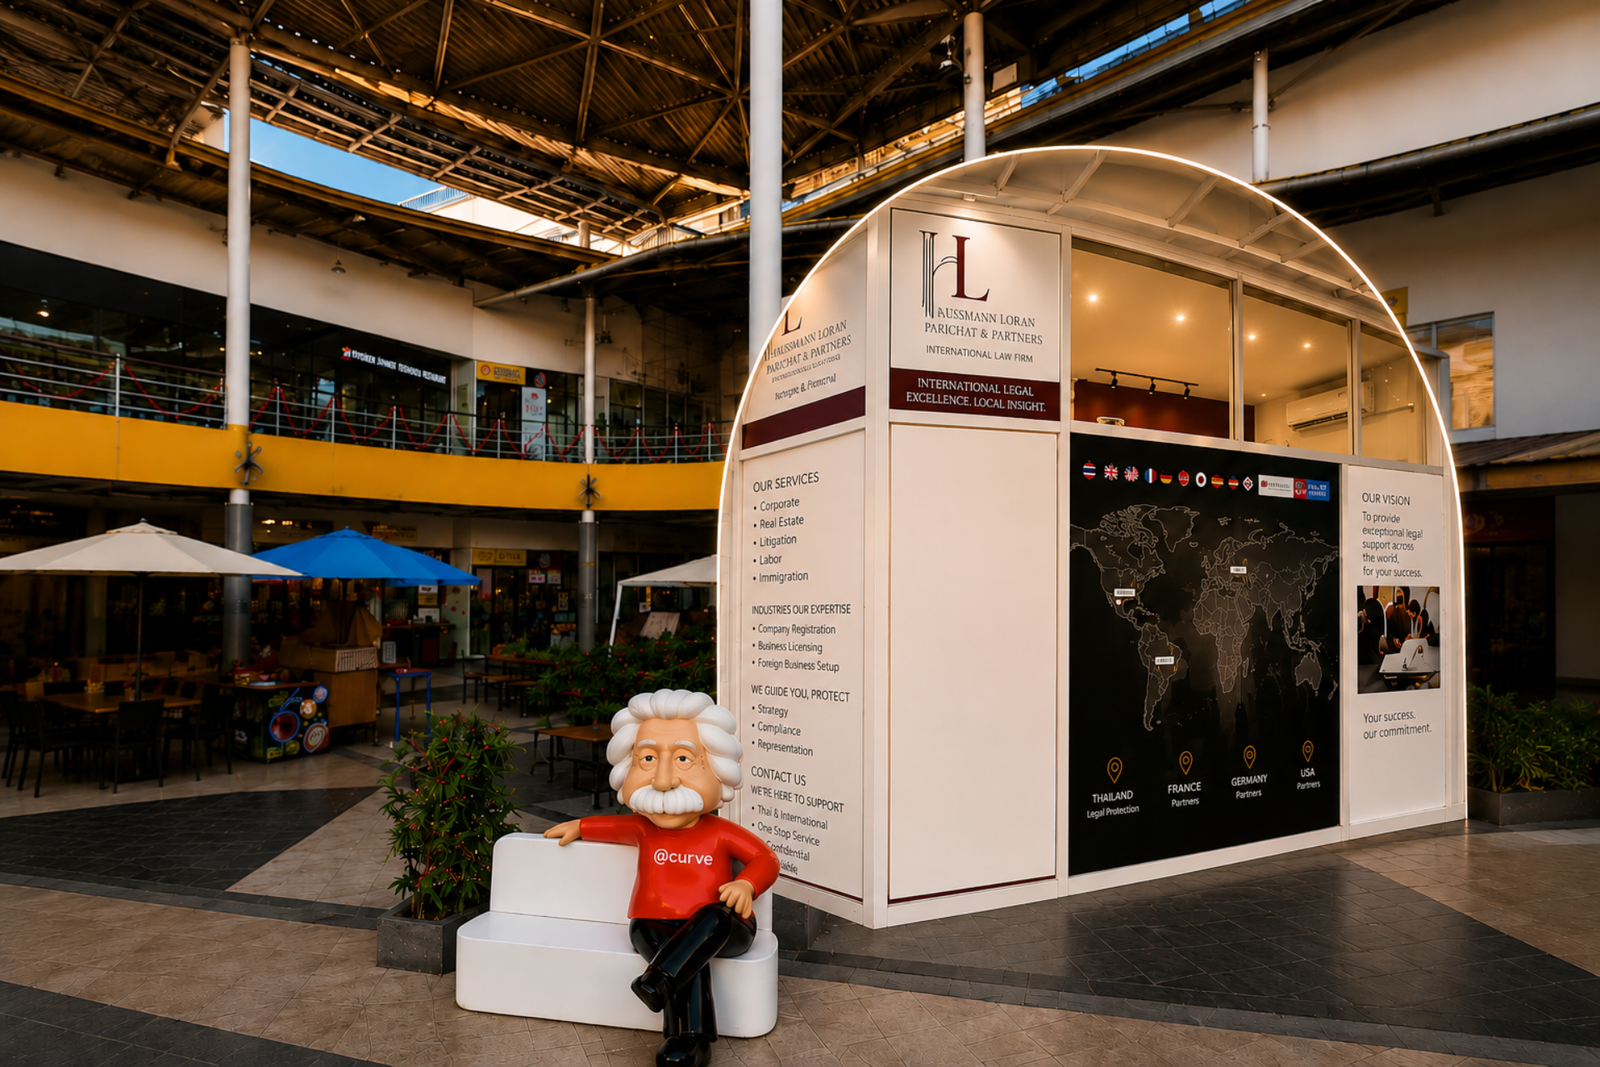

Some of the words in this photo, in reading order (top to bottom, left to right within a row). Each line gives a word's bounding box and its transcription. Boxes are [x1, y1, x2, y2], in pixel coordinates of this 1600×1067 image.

[1000, 314, 1036, 327] LORAN
[818, 319, 848, 341] LORAN
[924, 322, 978, 338] PARICHAT
[981, 328, 988, 339] &
[992, 331, 1043, 345] PARTNERS
[810, 334, 852, 358] PARTNERS
[926, 345, 992, 359] INTERNATIONAL
[994, 352, 1013, 361] LAW
[1014, 353, 1034, 363] FIRM
[917, 378, 1001, 394] INTERNATIONAL
[1003, 384, 1034, 397] LEGAL
[974, 396, 1005, 409] LOCAL
[1007, 399, 1046, 412] INSIGHT.
[753, 479, 773, 493] OUR
[775, 471, 820, 489] SERVICES
[760, 498, 800, 512] Corporate
[1362, 492, 1381, 503] OUR
[1382, 495, 1411, 506] VISION
[760, 517, 777, 529] Real
[779, 516, 805, 527] Estate
[1362, 511, 1372, 522] To
[759, 534, 797, 549] Litigation
[1405, 529, 1423, 541] legal
[1362, 540, 1391, 551] support
[759, 554, 782, 565] Labor
[1362, 552, 1376, 563] the
[759, 571, 809, 584] Immigration
[1362, 566, 1374, 576] for
[751, 605, 792, 615] INDUSTRIES
[792, 605, 809, 615] OUR
[810, 604, 851, 614] EXPERTISE
[757, 624, 791, 636] Company
[791, 624, 836, 636] Registration
[757, 641, 787, 651] Business
[788, 642, 823, 655] Licensing
[757, 658, 783, 671] Foreign
[784, 659, 816, 671] Business
[816, 660, 840, 674] Setup
[751, 684, 763, 695] WE
[764, 685, 789, 697] GUIDE
[789, 687, 810, 700] YOU,
[811, 689, 851, 702] PROTECT
[757, 703, 789, 718] Strategy
[1363, 713, 1382, 724] Your
[1383, 711, 1416, 722] success.
[757, 721, 802, 736] Compliance
[1363, 730, 1378, 740] our
[1379, 723, 1433, 738] commitment.
[757, 739, 814, 757] Representation
[751, 765, 793, 784] CONTACT
[793, 773, 807, 787] US
[1300, 768, 1316, 778] USA
[1168, 781, 1202, 794] FRANCE
[1231, 774, 1268, 787] GERMANY
[1297, 780, 1321, 790] Partners
[773, 789, 793, 803] HERE
[793, 793, 805, 805] TO
[806, 796, 845, 814] SUPPORT
[1092, 790, 1134, 804] THAILAND
[1236, 790, 1262, 799] Partners
[1171, 798, 1200, 808] Partners
[757, 804, 772, 818] Thai
[780, 810, 828, 830] International
[1086, 808, 1105, 820] Legal
[1106, 804, 1140, 816] Protection
[757, 821, 772, 835] One
[773, 825, 792, 841] Stop
[792, 830, 820, 847] Service
[653, 848, 713, 866] @curve
